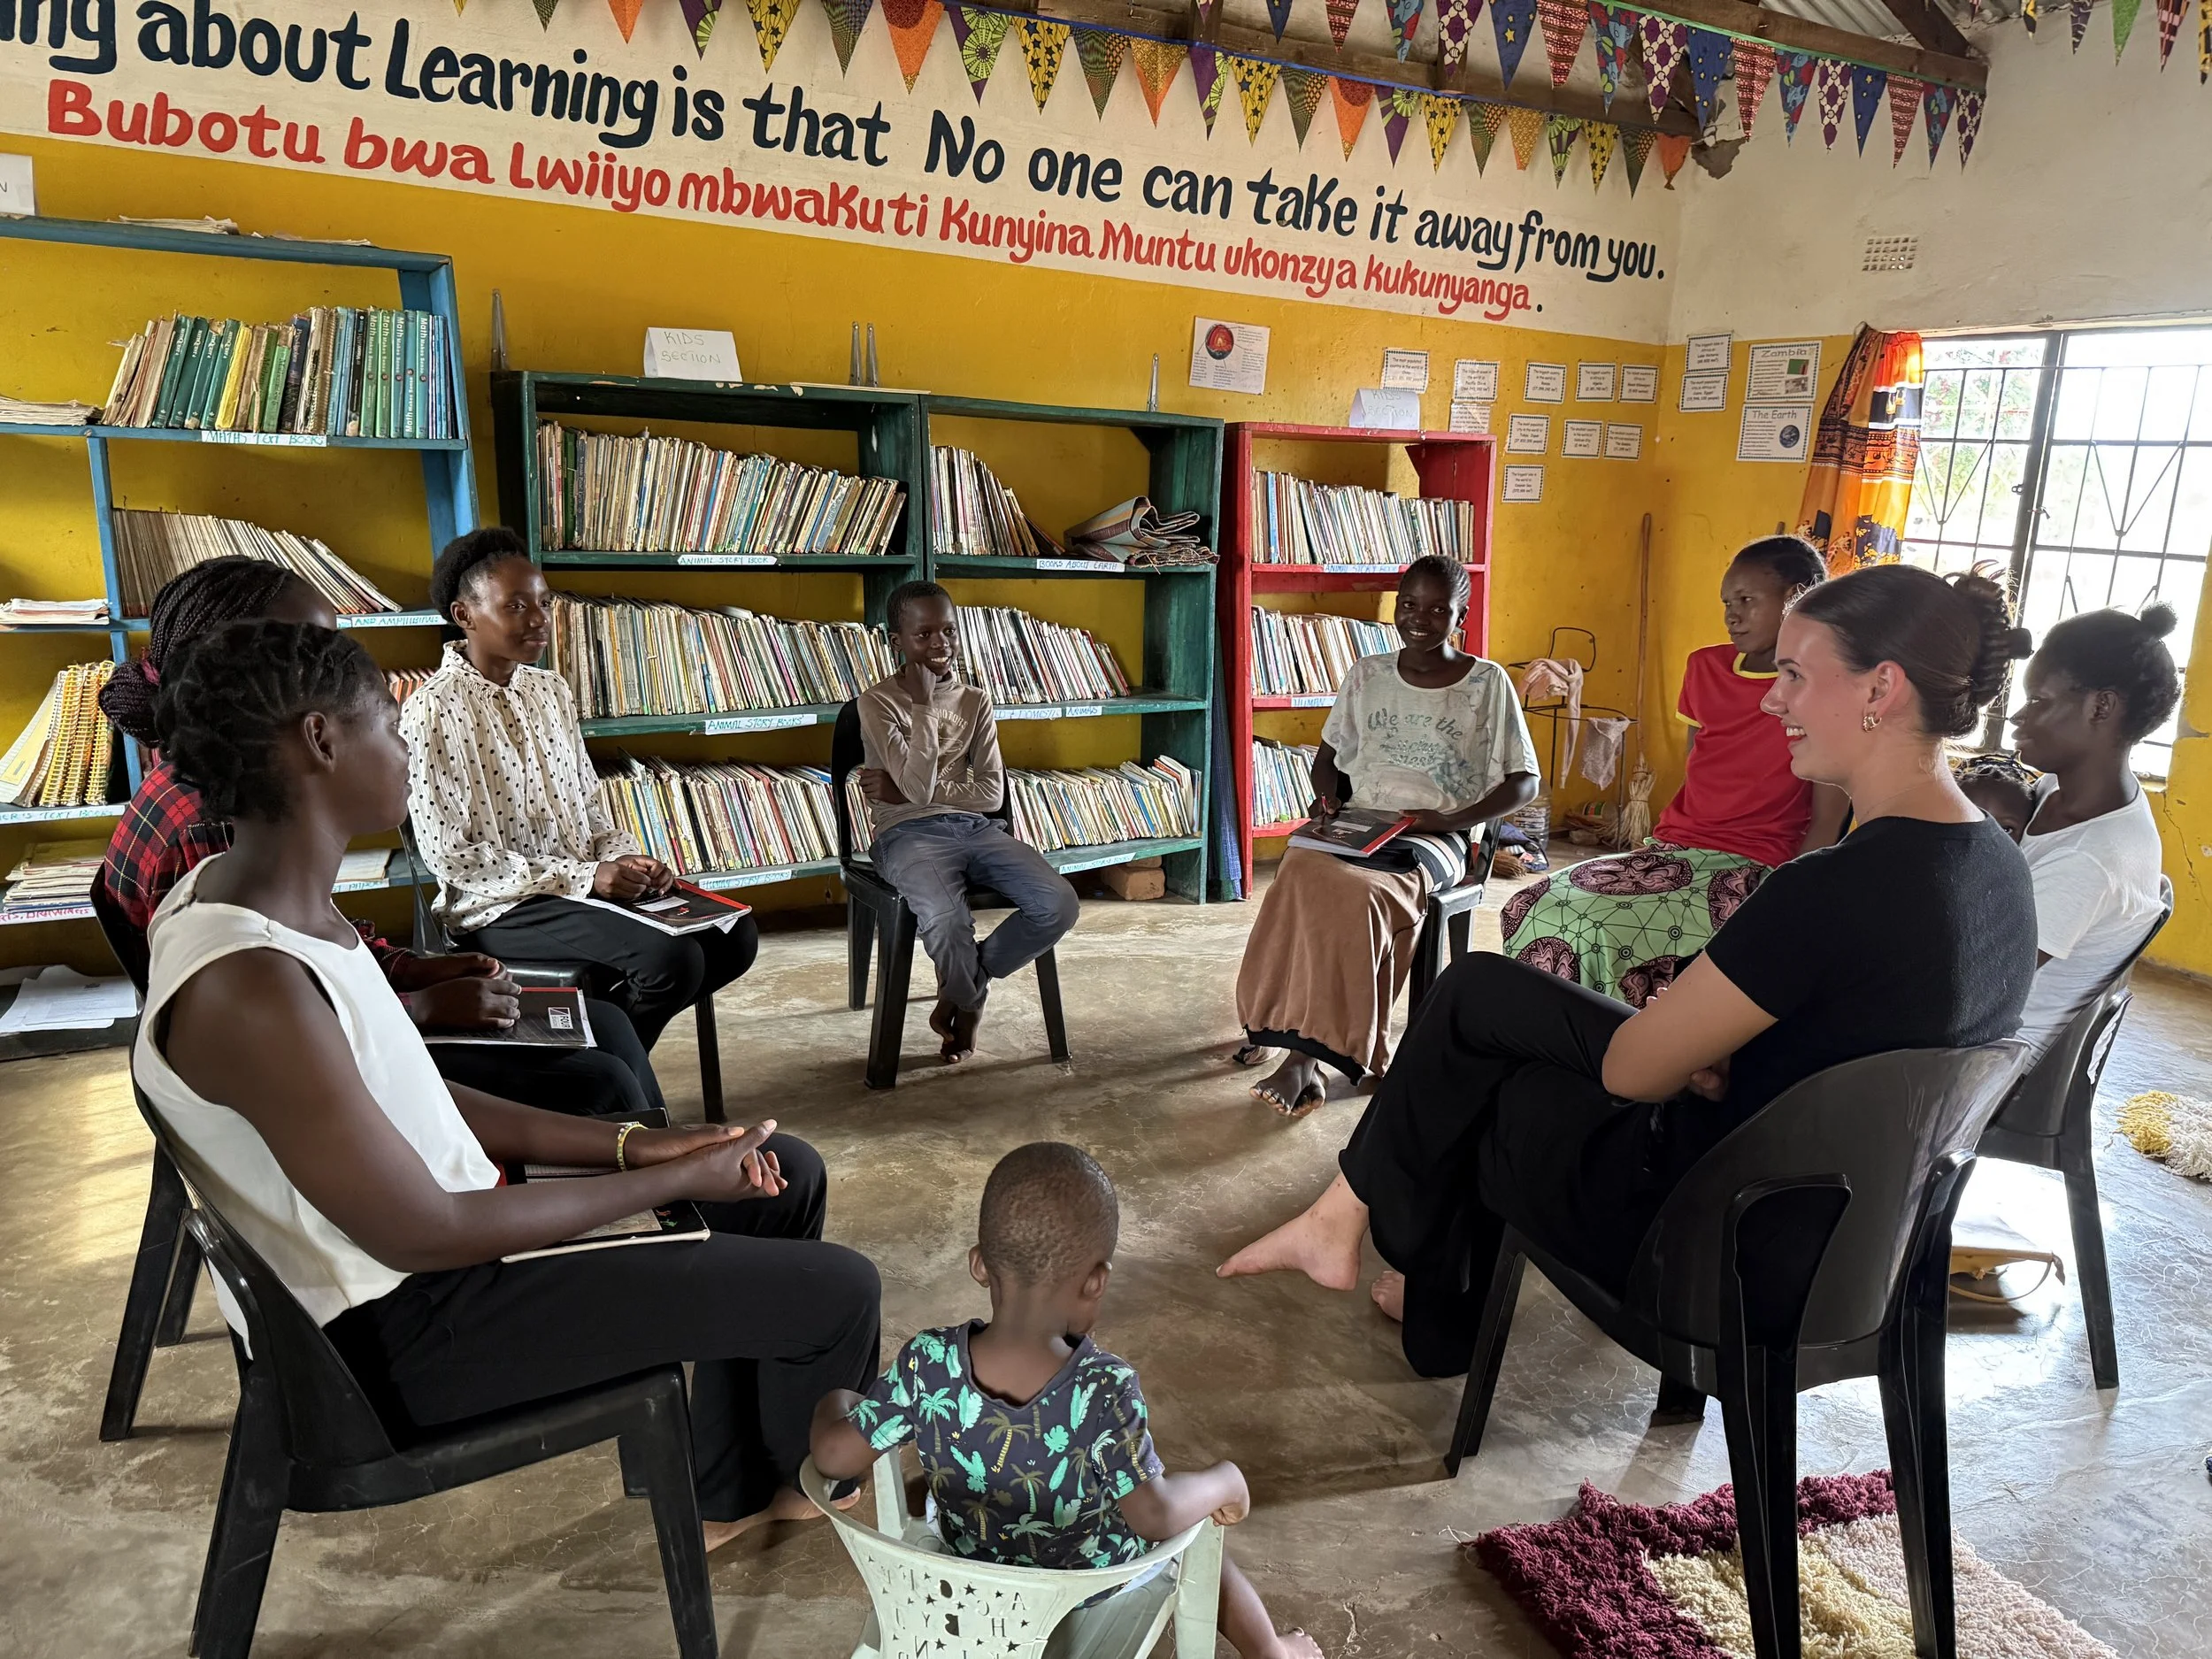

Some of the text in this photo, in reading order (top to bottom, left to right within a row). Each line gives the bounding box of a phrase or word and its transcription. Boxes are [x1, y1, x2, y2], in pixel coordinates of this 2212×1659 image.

[138, 0, 371, 90] about
[386, 19, 659, 149] Learning
[672, 65, 725, 142] is
[743, 86, 891, 166] that
[926, 111, 1005, 183] No
[1029, 149, 1122, 203] one
[1142, 165, 1233, 219] can
[1371, 186, 1408, 242] it
[1415, 209, 1513, 271] away
[1516, 210, 1601, 272] from
[48, 80, 326, 164] Bubotu
[343, 117, 495, 184] bwa
[510, 142, 671, 213] Lwiiyo
[940, 196, 1093, 264] Kunyina
[1097, 219, 1217, 272] Muntu
[1224, 237, 1357, 298] ukonzya
[369, 315, 378, 336] Math
[381, 315, 391, 337] Math
[396, 317, 404, 338] Math
[419, 318, 428, 339] Math
[664, 331, 704, 346] KIDS
[661, 349, 722, 365] SECTION
[1762, 349, 1807, 357] Zambia
[404, 411, 414, 433] Math
[1752, 410, 1797, 419] The Earth
[289, 434, 324, 445] BOOKS
[1039, 560, 1063, 569] BOOKS
[707, 720, 741, 730] ANIMAL
[745, 718, 774, 729] STORY
[1367, 707, 1399, 732] We
[1435, 716, 1463, 741] the
